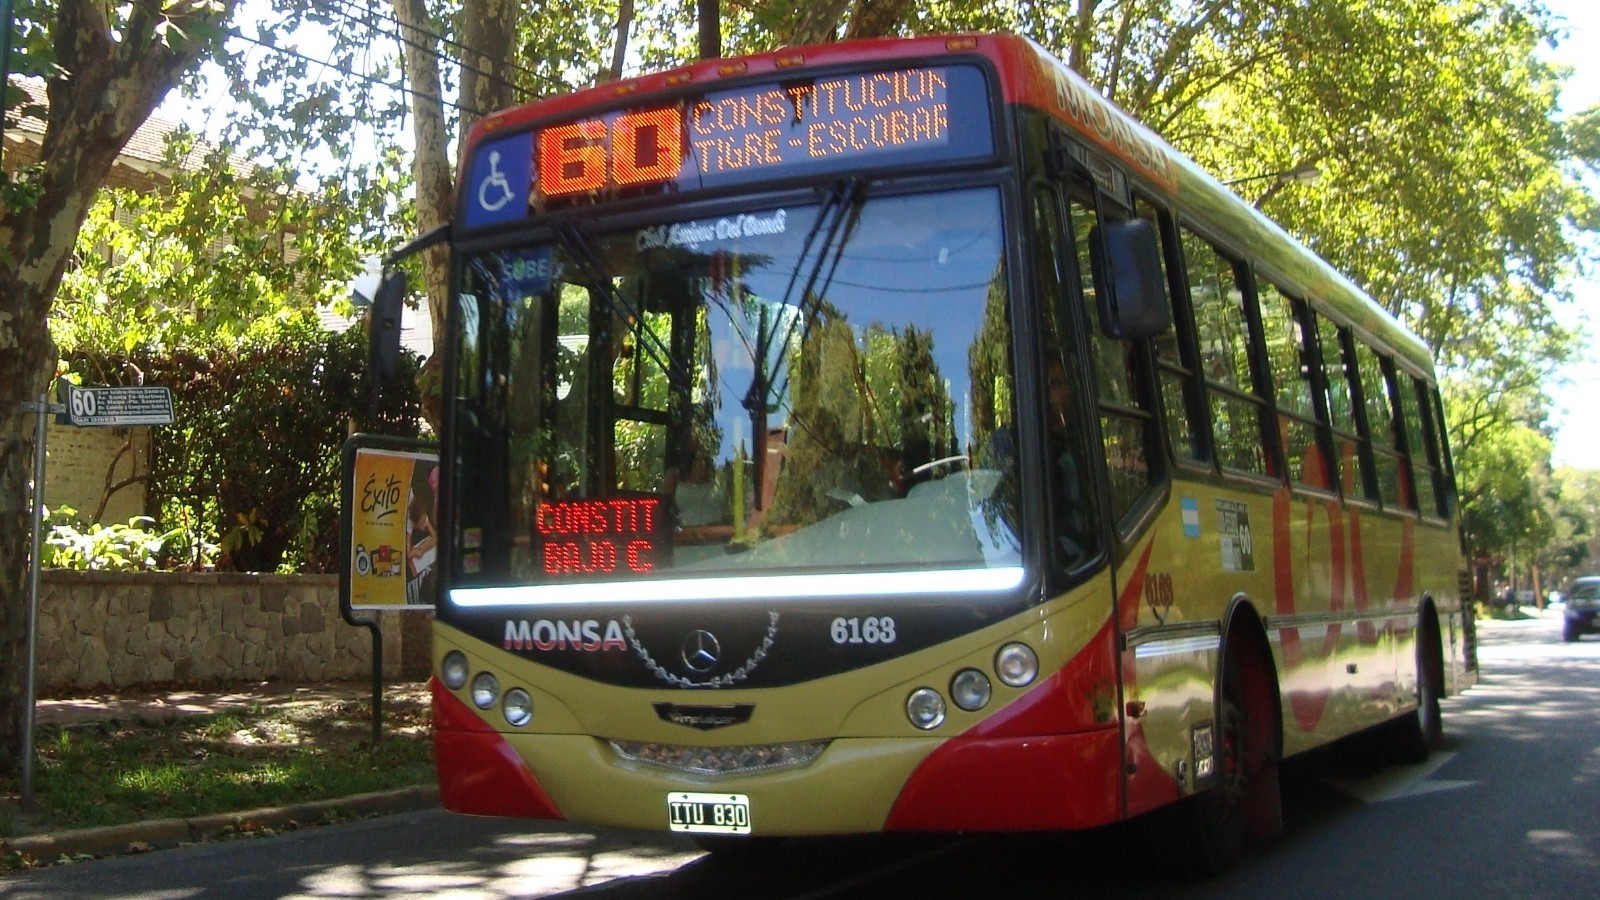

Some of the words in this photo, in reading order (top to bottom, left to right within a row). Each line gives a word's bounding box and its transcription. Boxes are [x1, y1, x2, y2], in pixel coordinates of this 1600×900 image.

[540, 107, 681, 196] 60
[72, 389, 96, 416] 60
[361, 472, 402, 512] Éxito
[537, 498, 659, 534] CONSTIT
[1240, 524, 1251, 555] 60
[545, 541, 616, 574] BAJO
[627, 540, 653, 573] C
[504, 619, 628, 652] MONSA
[830, 616, 897, 645] 6163
[671, 802, 705, 825] ITU
[713, 804, 747, 827] 830
